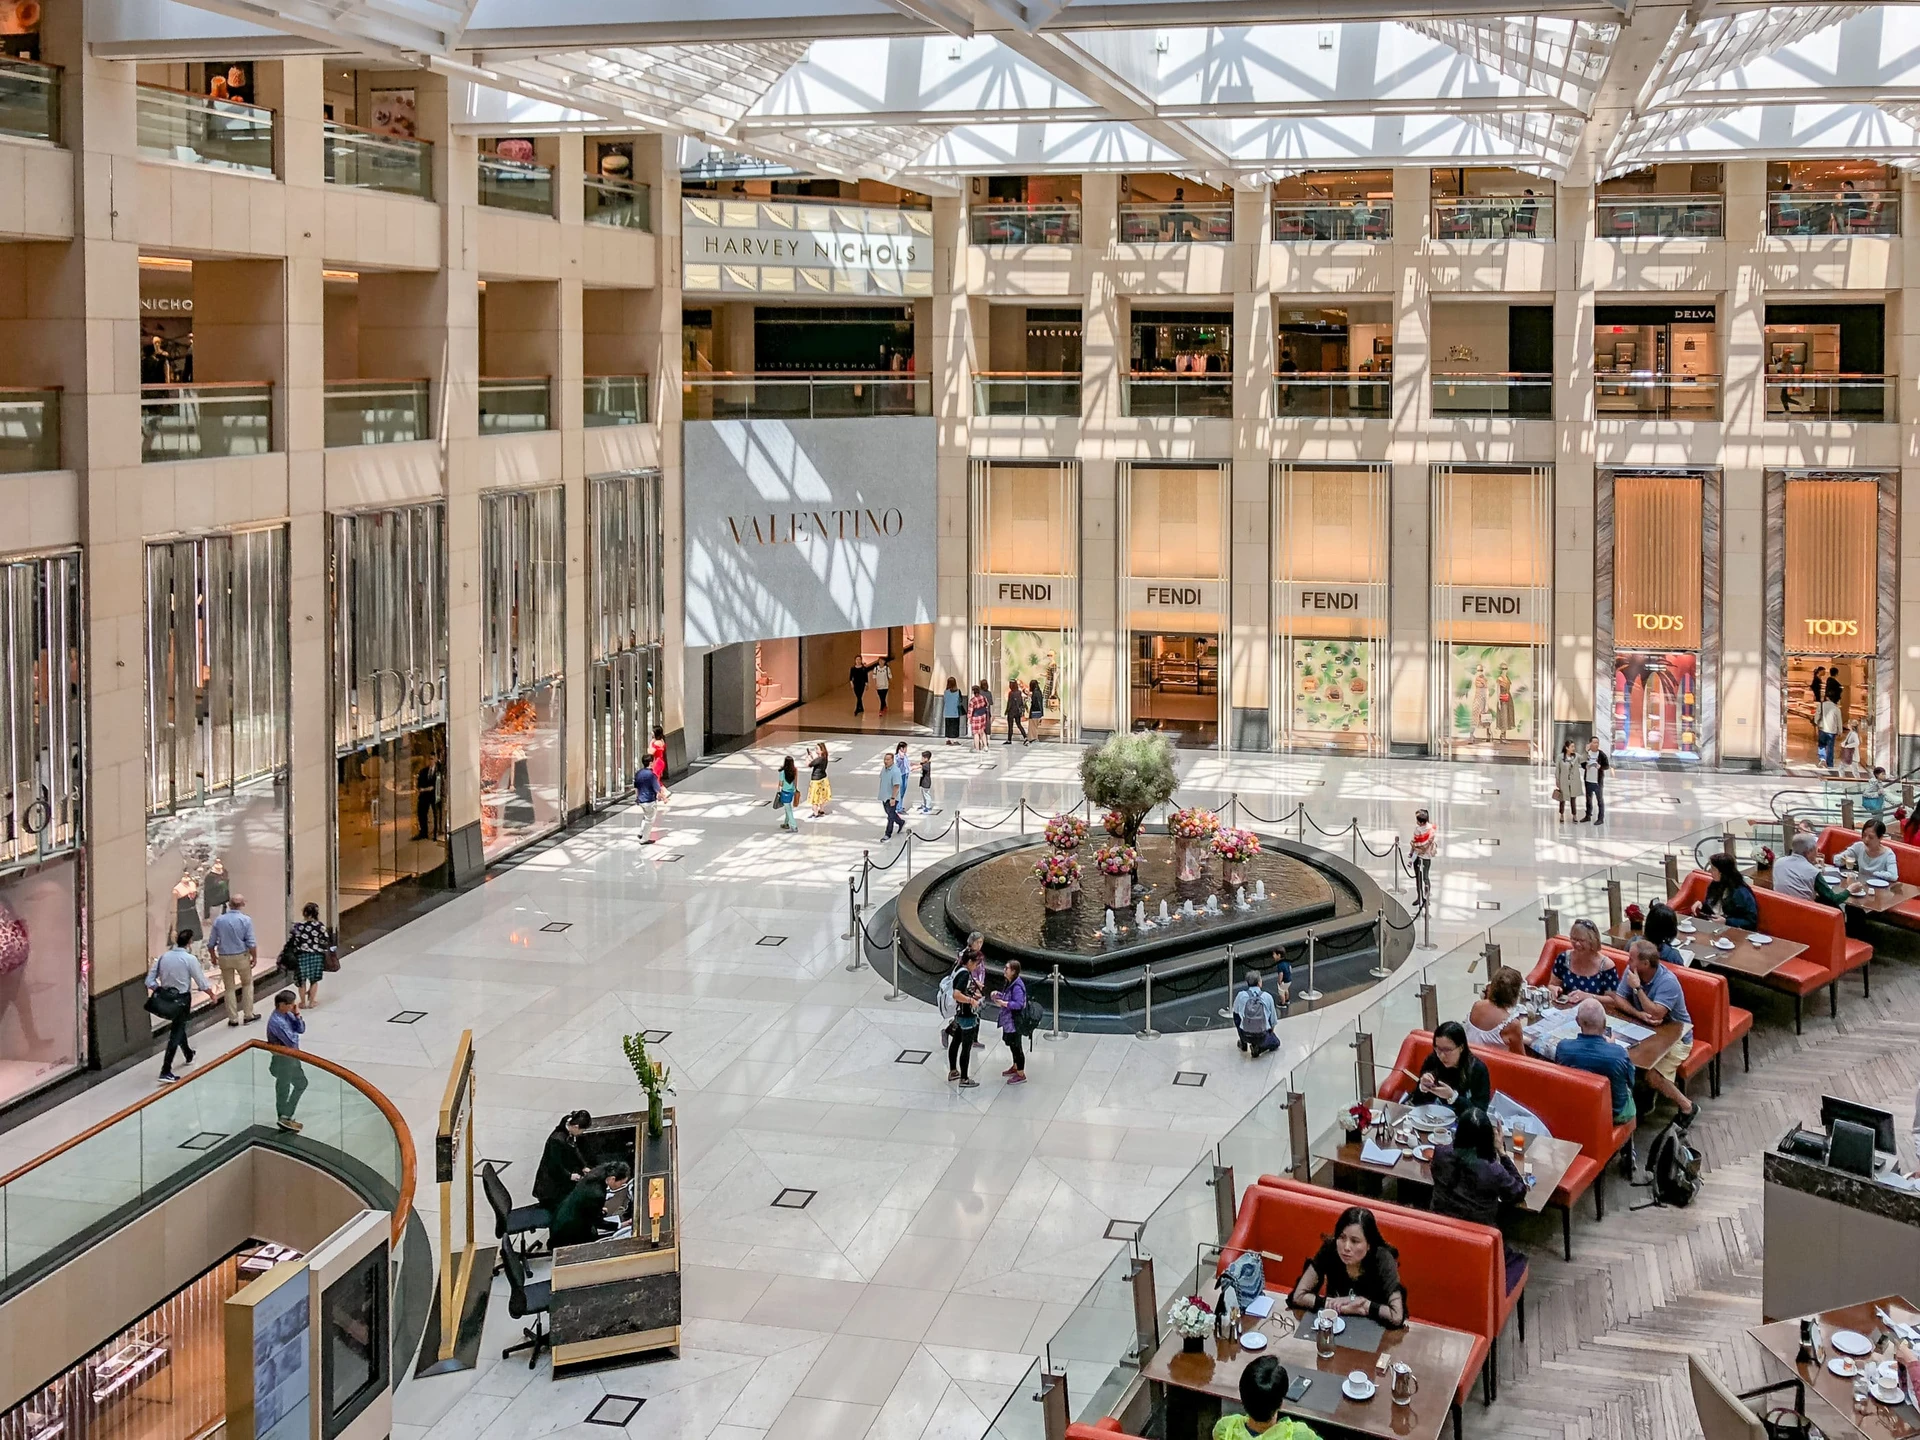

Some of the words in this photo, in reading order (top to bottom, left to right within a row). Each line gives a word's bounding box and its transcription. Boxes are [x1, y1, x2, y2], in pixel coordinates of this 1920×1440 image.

[704, 236, 799, 257] HARVEY
[814, 241, 916, 264] NICHOLS
[140, 299, 193, 310] NICHO
[1674, 310, 1714, 319] DELVA
[727, 507, 904, 546] VALENTINO
[998, 583, 1052, 600] FENDI
[1146, 587, 1201, 605] FENDI
[1301, 591, 1358, 610] FENDI
[1462, 595, 1521, 614] FENDI
[1632, 613, 1685, 631] TOD'S
[1803, 618, 1859, 636] TOD'S
[370, 668, 448, 721] Dior
